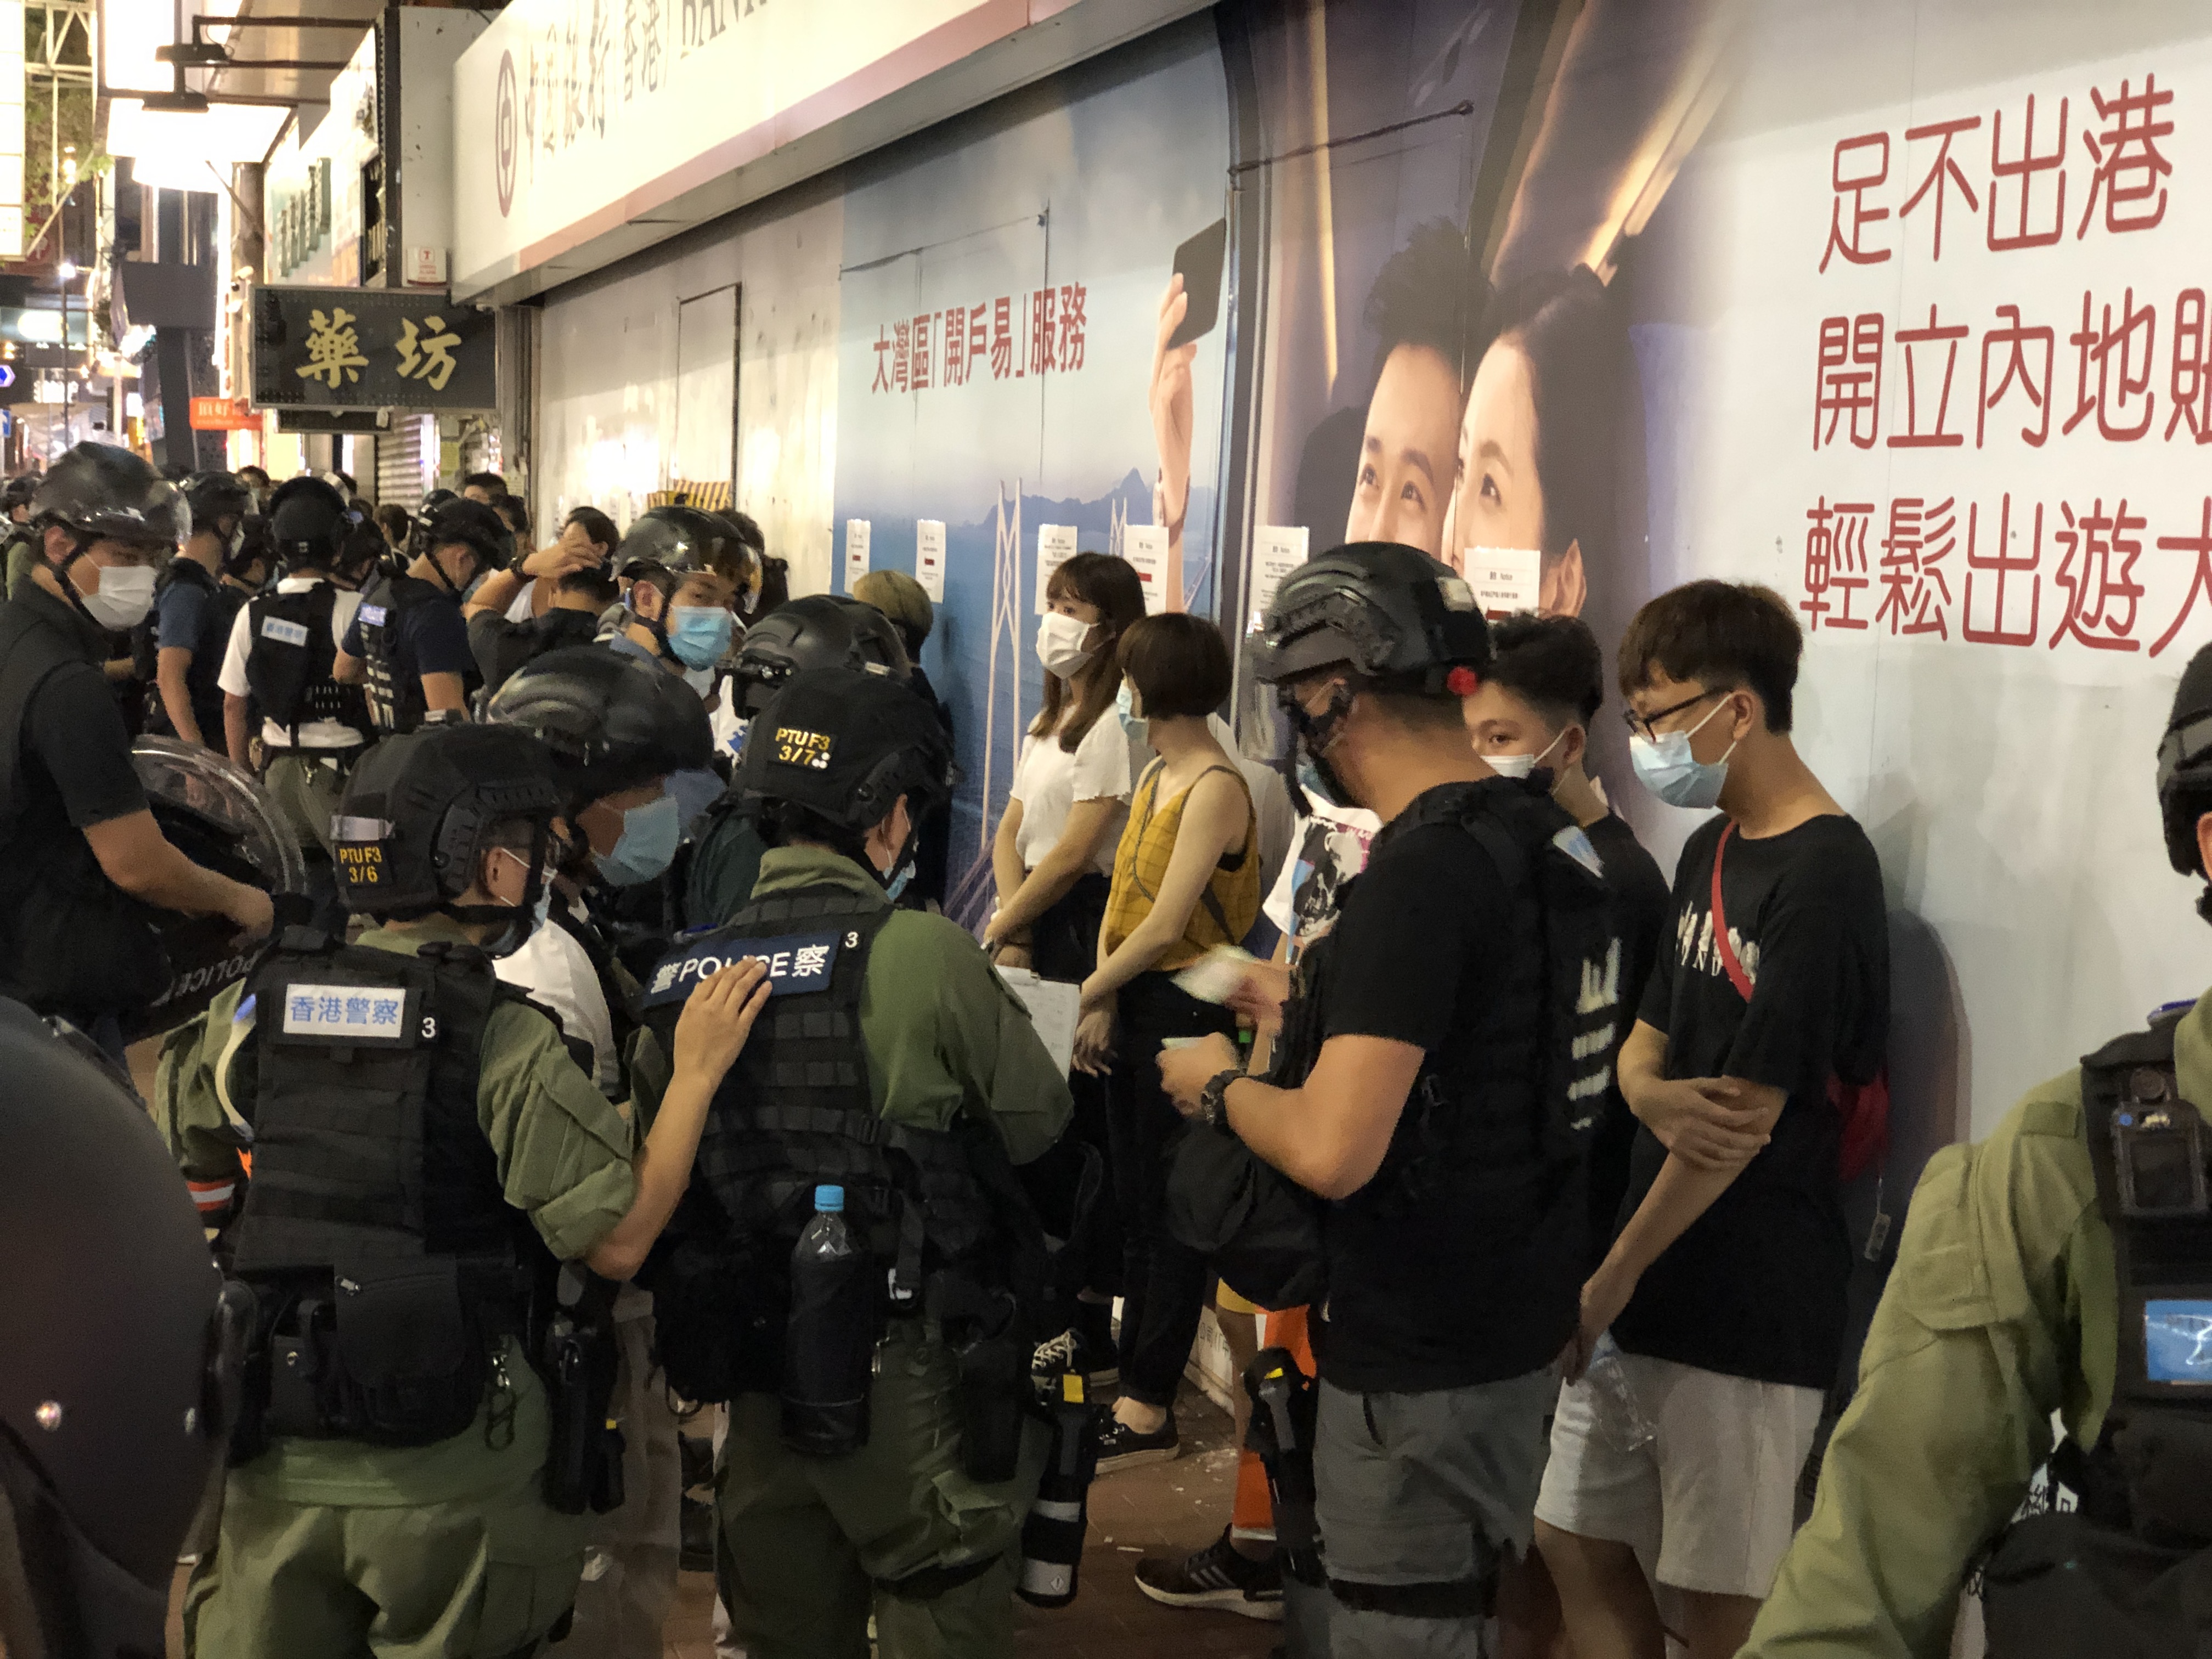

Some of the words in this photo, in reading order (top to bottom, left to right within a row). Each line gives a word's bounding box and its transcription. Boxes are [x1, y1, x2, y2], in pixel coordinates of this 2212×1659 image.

[1819, 73, 2174, 274] 足不出港
[296, 307, 461, 391] 藥坊
[775, 728, 809, 745] PTU
[808, 733, 831, 750] F3
[778, 745, 815, 765] 3/7
[339, 848, 363, 864] PTU
[364, 847, 382, 863] F3
[349, 865, 379, 883] 3/6
[845, 932, 859, 948] 3
[291, 996, 398, 1025] 香港警察
[421, 1017, 436, 1039] 3
